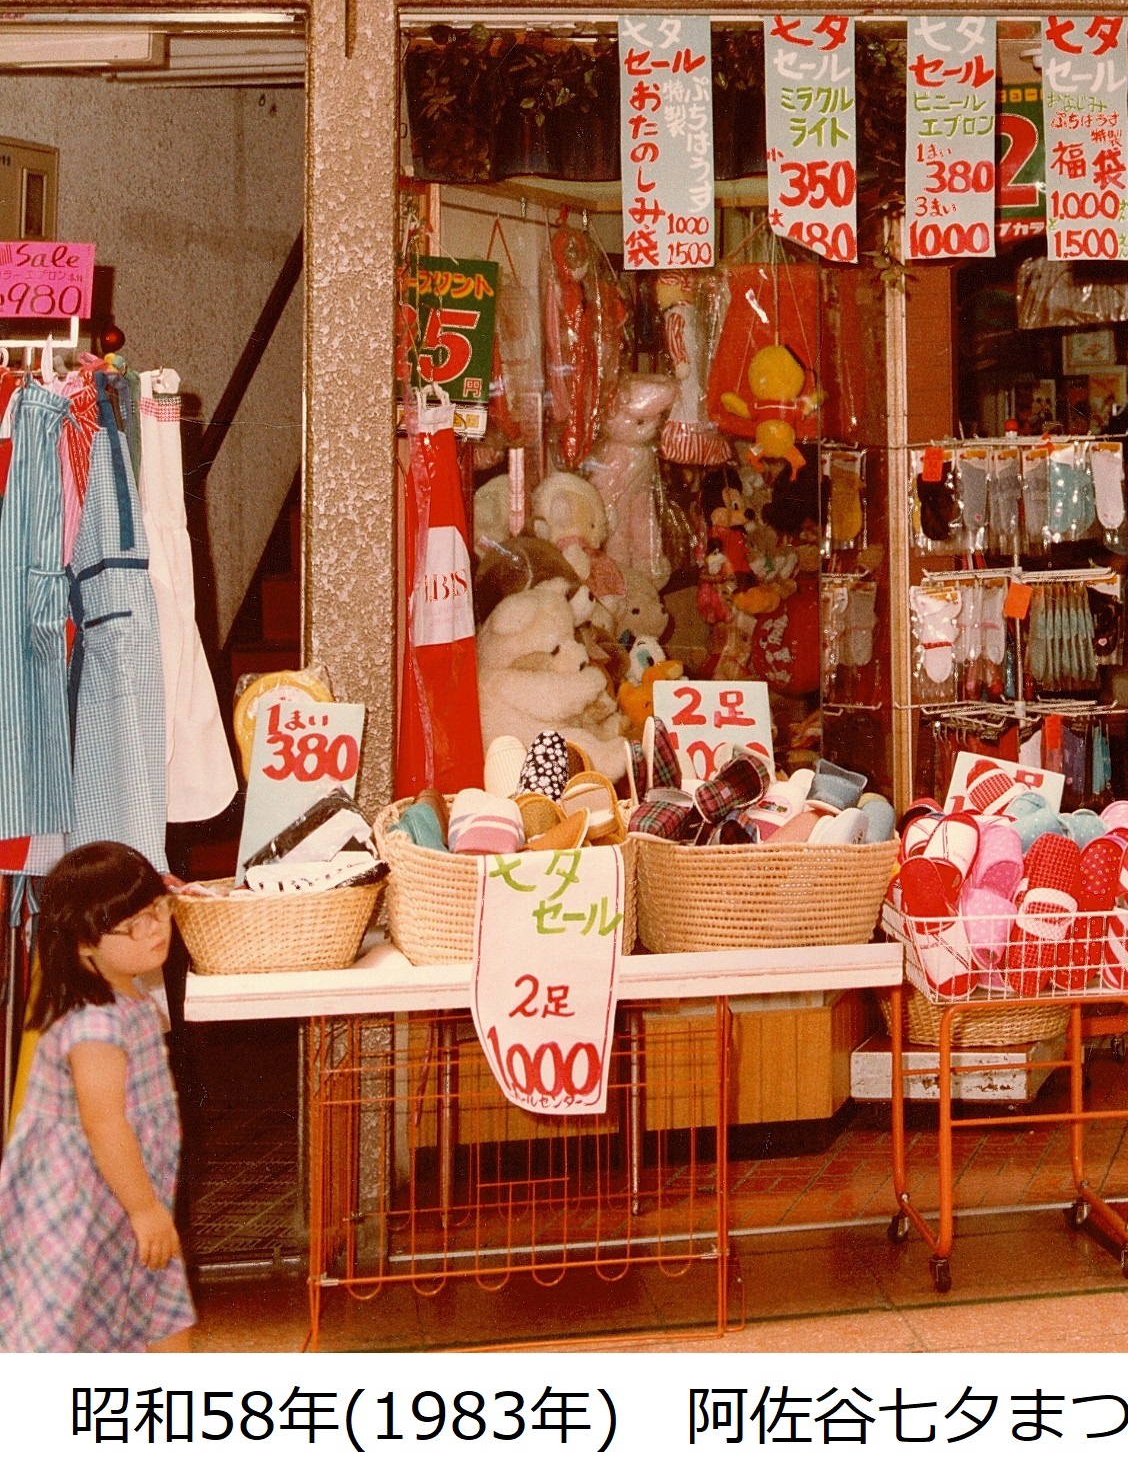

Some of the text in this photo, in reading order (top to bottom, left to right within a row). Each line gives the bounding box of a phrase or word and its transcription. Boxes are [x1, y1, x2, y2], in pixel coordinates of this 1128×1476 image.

[624, 48, 706, 76] セール
[774, 48, 851, 82] セール
[908, 54, 995, 88] セール
[1047, 58, 1128, 93] セール
[781, 86, 855, 113] ミラクル
[913, 93, 987, 112] ビニール
[789, 117, 850, 148] ライト
[918, 114, 995, 139] エプロン
[624, 80, 666, 267] おたのしみ袋
[924, 160, 995, 194] 380
[1050, 140, 1127, 191] 福袋
[779, 160, 857, 209] 350
[667, 213, 709, 236] 1000
[909, 220, 990, 258] 1000
[16, 243, 80, 268] Sale
[667, 242, 712, 266] 1500
[0, 283, 83, 315] 980
[671, 686, 756, 729] 2足
[262, 732, 359, 782] 380
[532, 897, 623, 936] セール
[509, 974, 575, 1018] 2足
[487, 1026, 601, 1097] 1000
